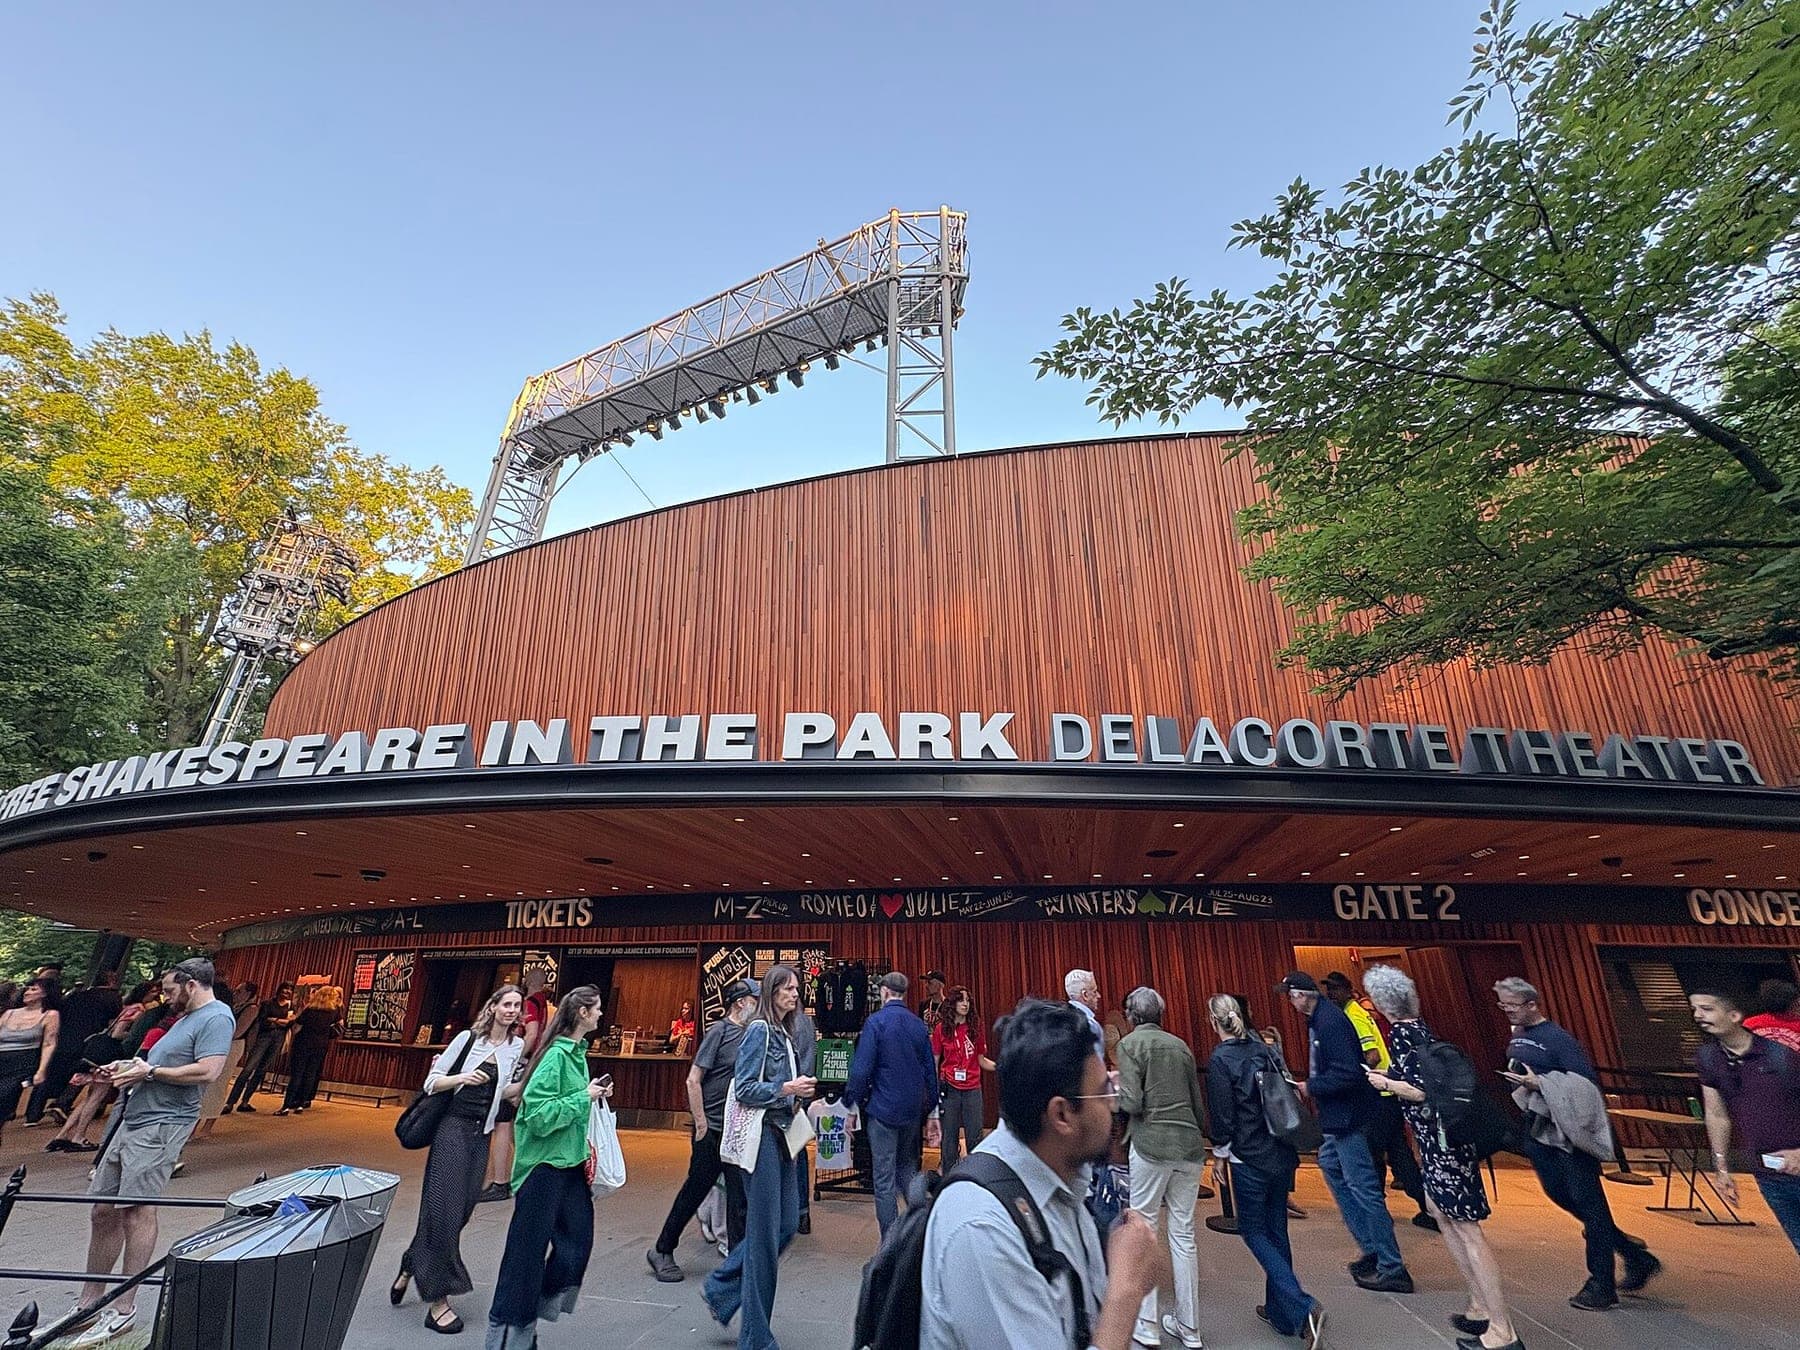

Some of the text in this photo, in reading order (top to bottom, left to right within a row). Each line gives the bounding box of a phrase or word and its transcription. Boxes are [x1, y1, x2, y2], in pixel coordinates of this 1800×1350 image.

[54, 724, 469, 806] SHAKESPEARE
[481, 718, 567, 766] IN
[588, 713, 757, 765] THE
[782, 711, 1019, 761] PARK
[1051, 713, 1765, 786] DELACORTE THEATER
[505, 898, 594, 929] TICKETS
[714, 895, 764, 919] M-Z
[800, 893, 868, 918] ROMEO
[905, 891, 985, 918] JULIET
[1035, 888, 1239, 917] THE WINTER'S TALE
[1333, 884, 1461, 921] GATE 2
[1686, 888, 1800, 927] CONCE
[663, 946, 697, 955] FOUNDATION
[703, 966, 726, 995] HOW
[729, 945, 752, 972] GET
